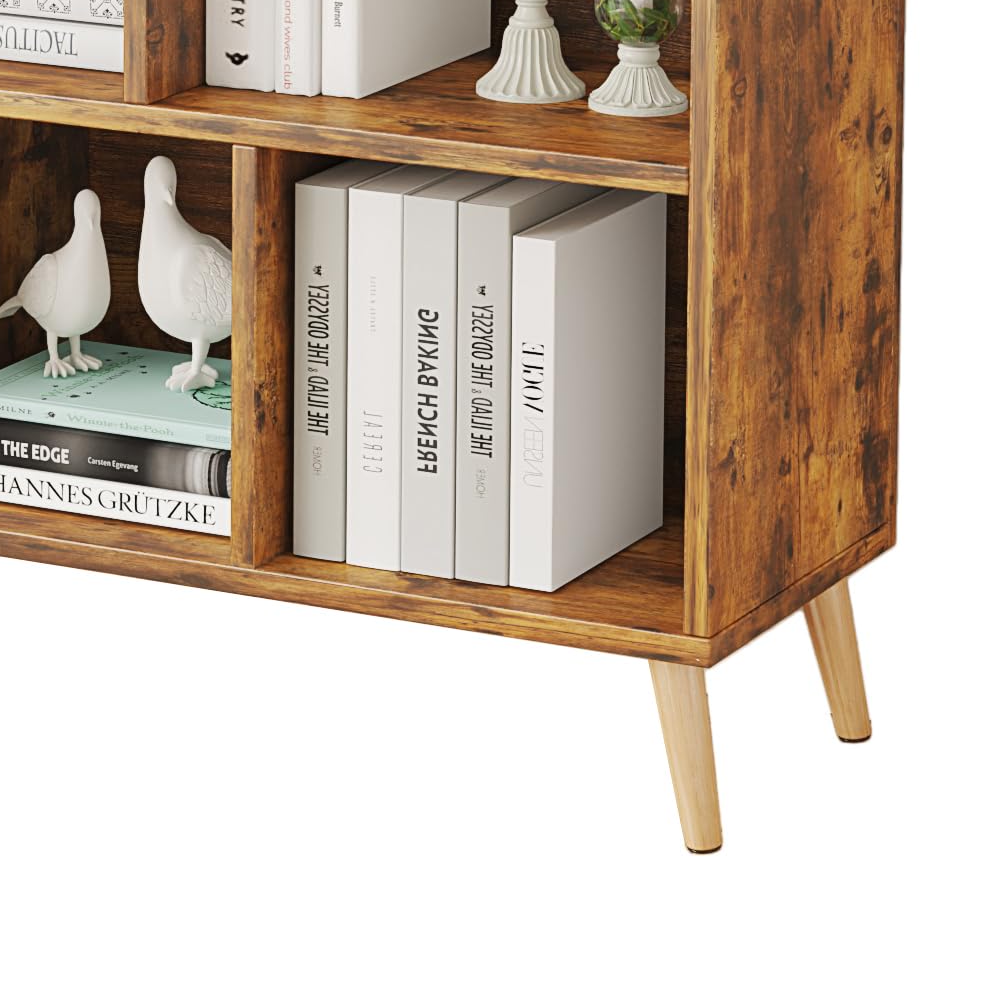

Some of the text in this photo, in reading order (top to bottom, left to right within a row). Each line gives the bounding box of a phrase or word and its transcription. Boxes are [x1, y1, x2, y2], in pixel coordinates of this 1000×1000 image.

[333, 1, 343, 27] Burnett
[284, 26, 293, 61] wives
[283, 63, 293, 90] club
[1, 439, 29, 459] THE
[31, 445, 70, 465] EDGE
[87, 456, 111, 468] Carsten
[98, 489, 217, 526] GRÜTZKE
